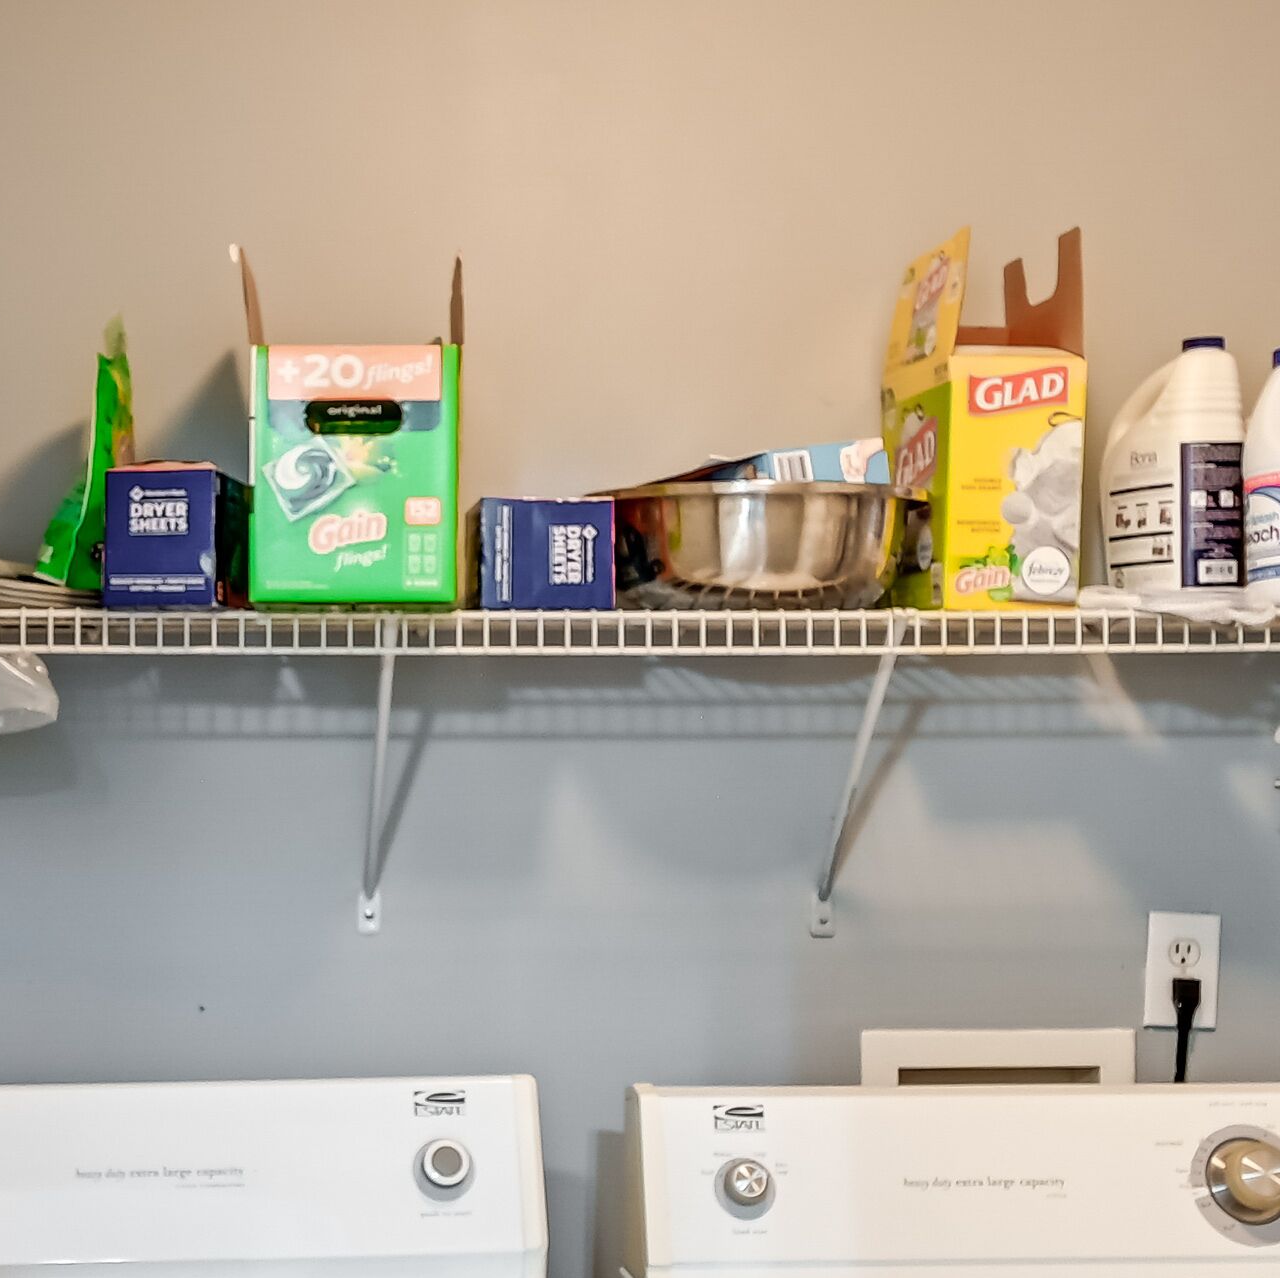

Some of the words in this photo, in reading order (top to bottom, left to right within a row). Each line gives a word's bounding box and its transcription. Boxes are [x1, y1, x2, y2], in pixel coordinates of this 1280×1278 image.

[276, 353, 365, 389] +20
[363, 355, 434, 391] flings!
[974, 371, 1066, 411] GLAD
[326, 403, 383, 418] original
[130, 502, 188, 517] DRYER
[130, 517, 188, 532] SHEETS
[308, 511, 388, 555] Gain
[334, 544, 388, 572] flings!
[552, 525, 567, 584] SHEETS
[566, 525, 582, 584] DRYER
[954, 565, 1011, 595] Gain
[130, 1170, 159, 1178] extra
[163, 1166, 193, 1180] large
[197, 1167, 244, 1180] capacity
[955, 1179, 984, 1187] extra
[987, 1176, 1015, 1190] large
[1020, 1178, 1065, 1190] capacity
